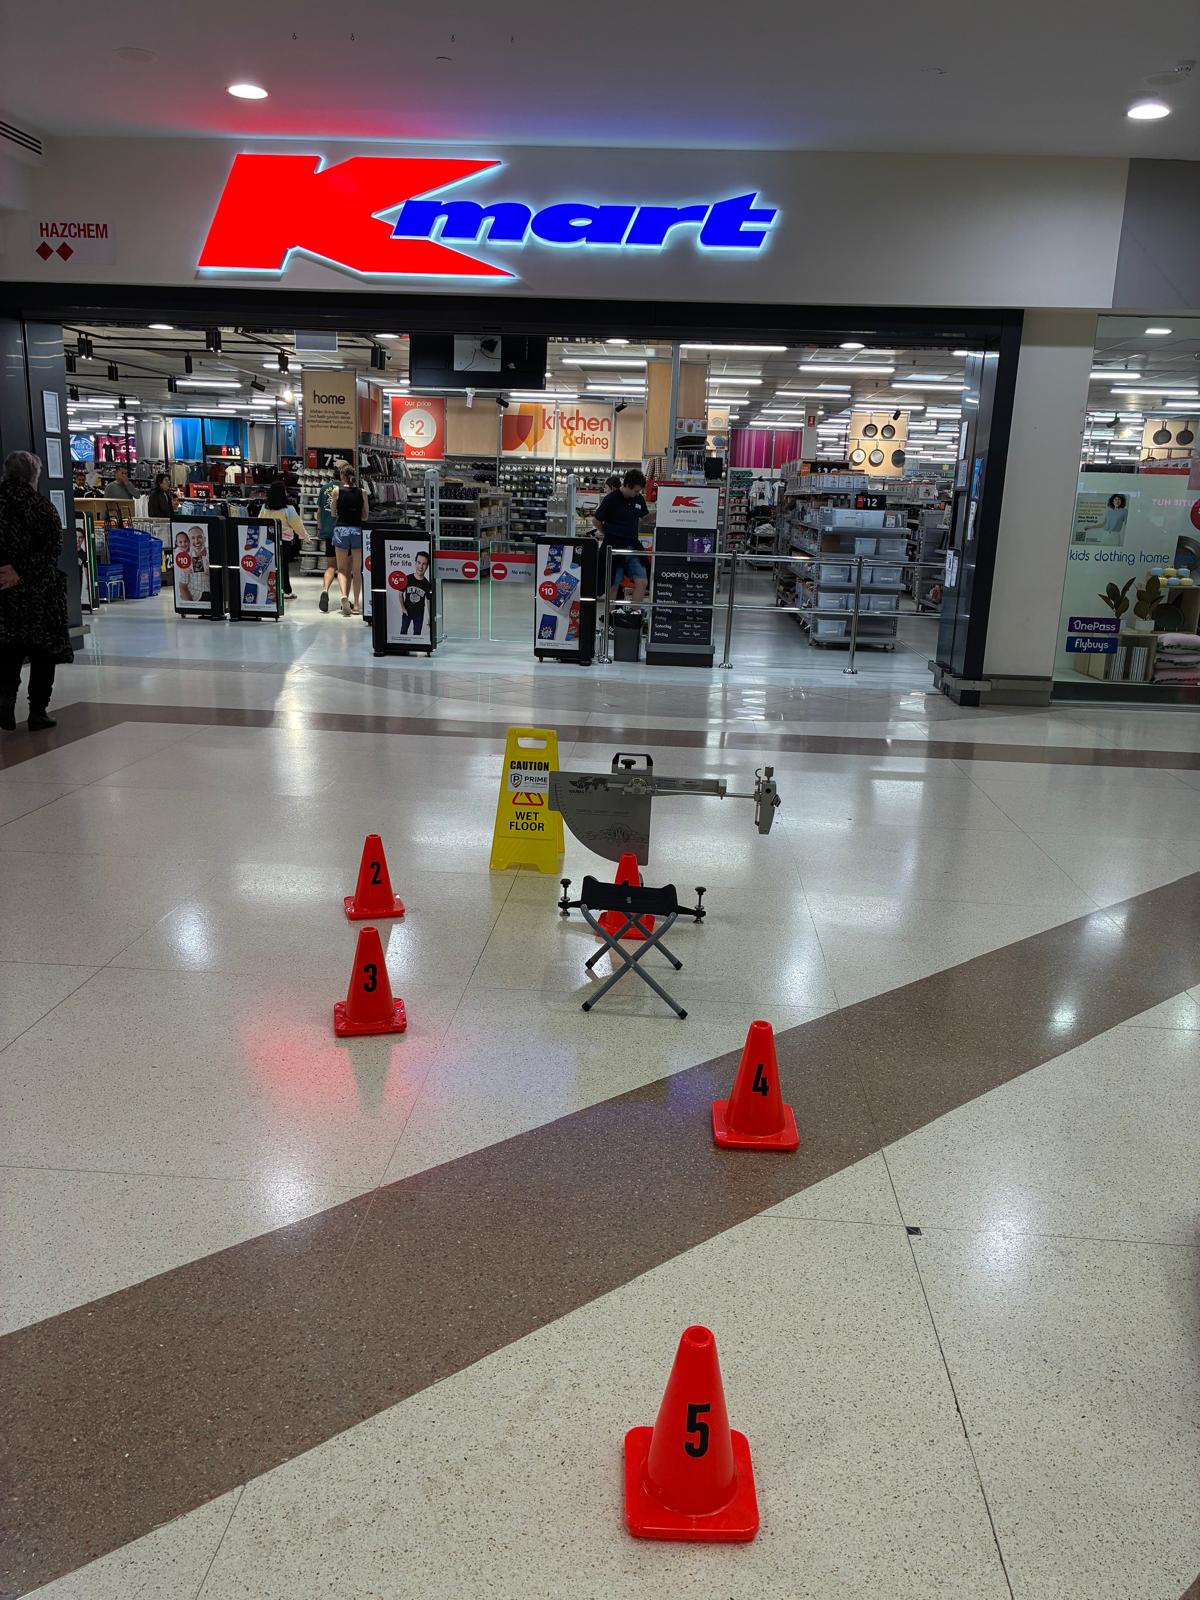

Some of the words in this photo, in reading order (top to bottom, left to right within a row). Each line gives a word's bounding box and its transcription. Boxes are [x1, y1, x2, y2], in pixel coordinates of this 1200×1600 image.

[196, 152, 779, 278] Kmart
[39, 222, 109, 239] HAZCHEM
[313, 390, 346, 405] home
[542, 408, 612, 432] kitchen
[409, 420, 425, 436] $2
[575, 432, 609, 450] dining
[410, 449, 426, 457] each
[177, 556, 189, 566] $10
[389, 552, 411, 560] prices
[1069, 550, 1090, 561] kids
[1094, 551, 1136, 566] clothing
[1140, 552, 1170, 563] home
[243, 559, 254, 568] $10
[661, 571, 689, 580] opening
[690, 571, 709, 579] hours
[541, 587, 554, 596] $10
[1073, 620, 1116, 631] OnePass
[1074, 639, 1109, 652] flybuys
[510, 760, 549, 772] CAUTION
[515, 811, 540, 821] WET
[509, 821, 545, 832] FLOOR
[370, 861, 382, 885] 2
[363, 963, 378, 993] 3
[752, 1063, 769, 1097] 4
[684, 1403, 711, 1458] 5
